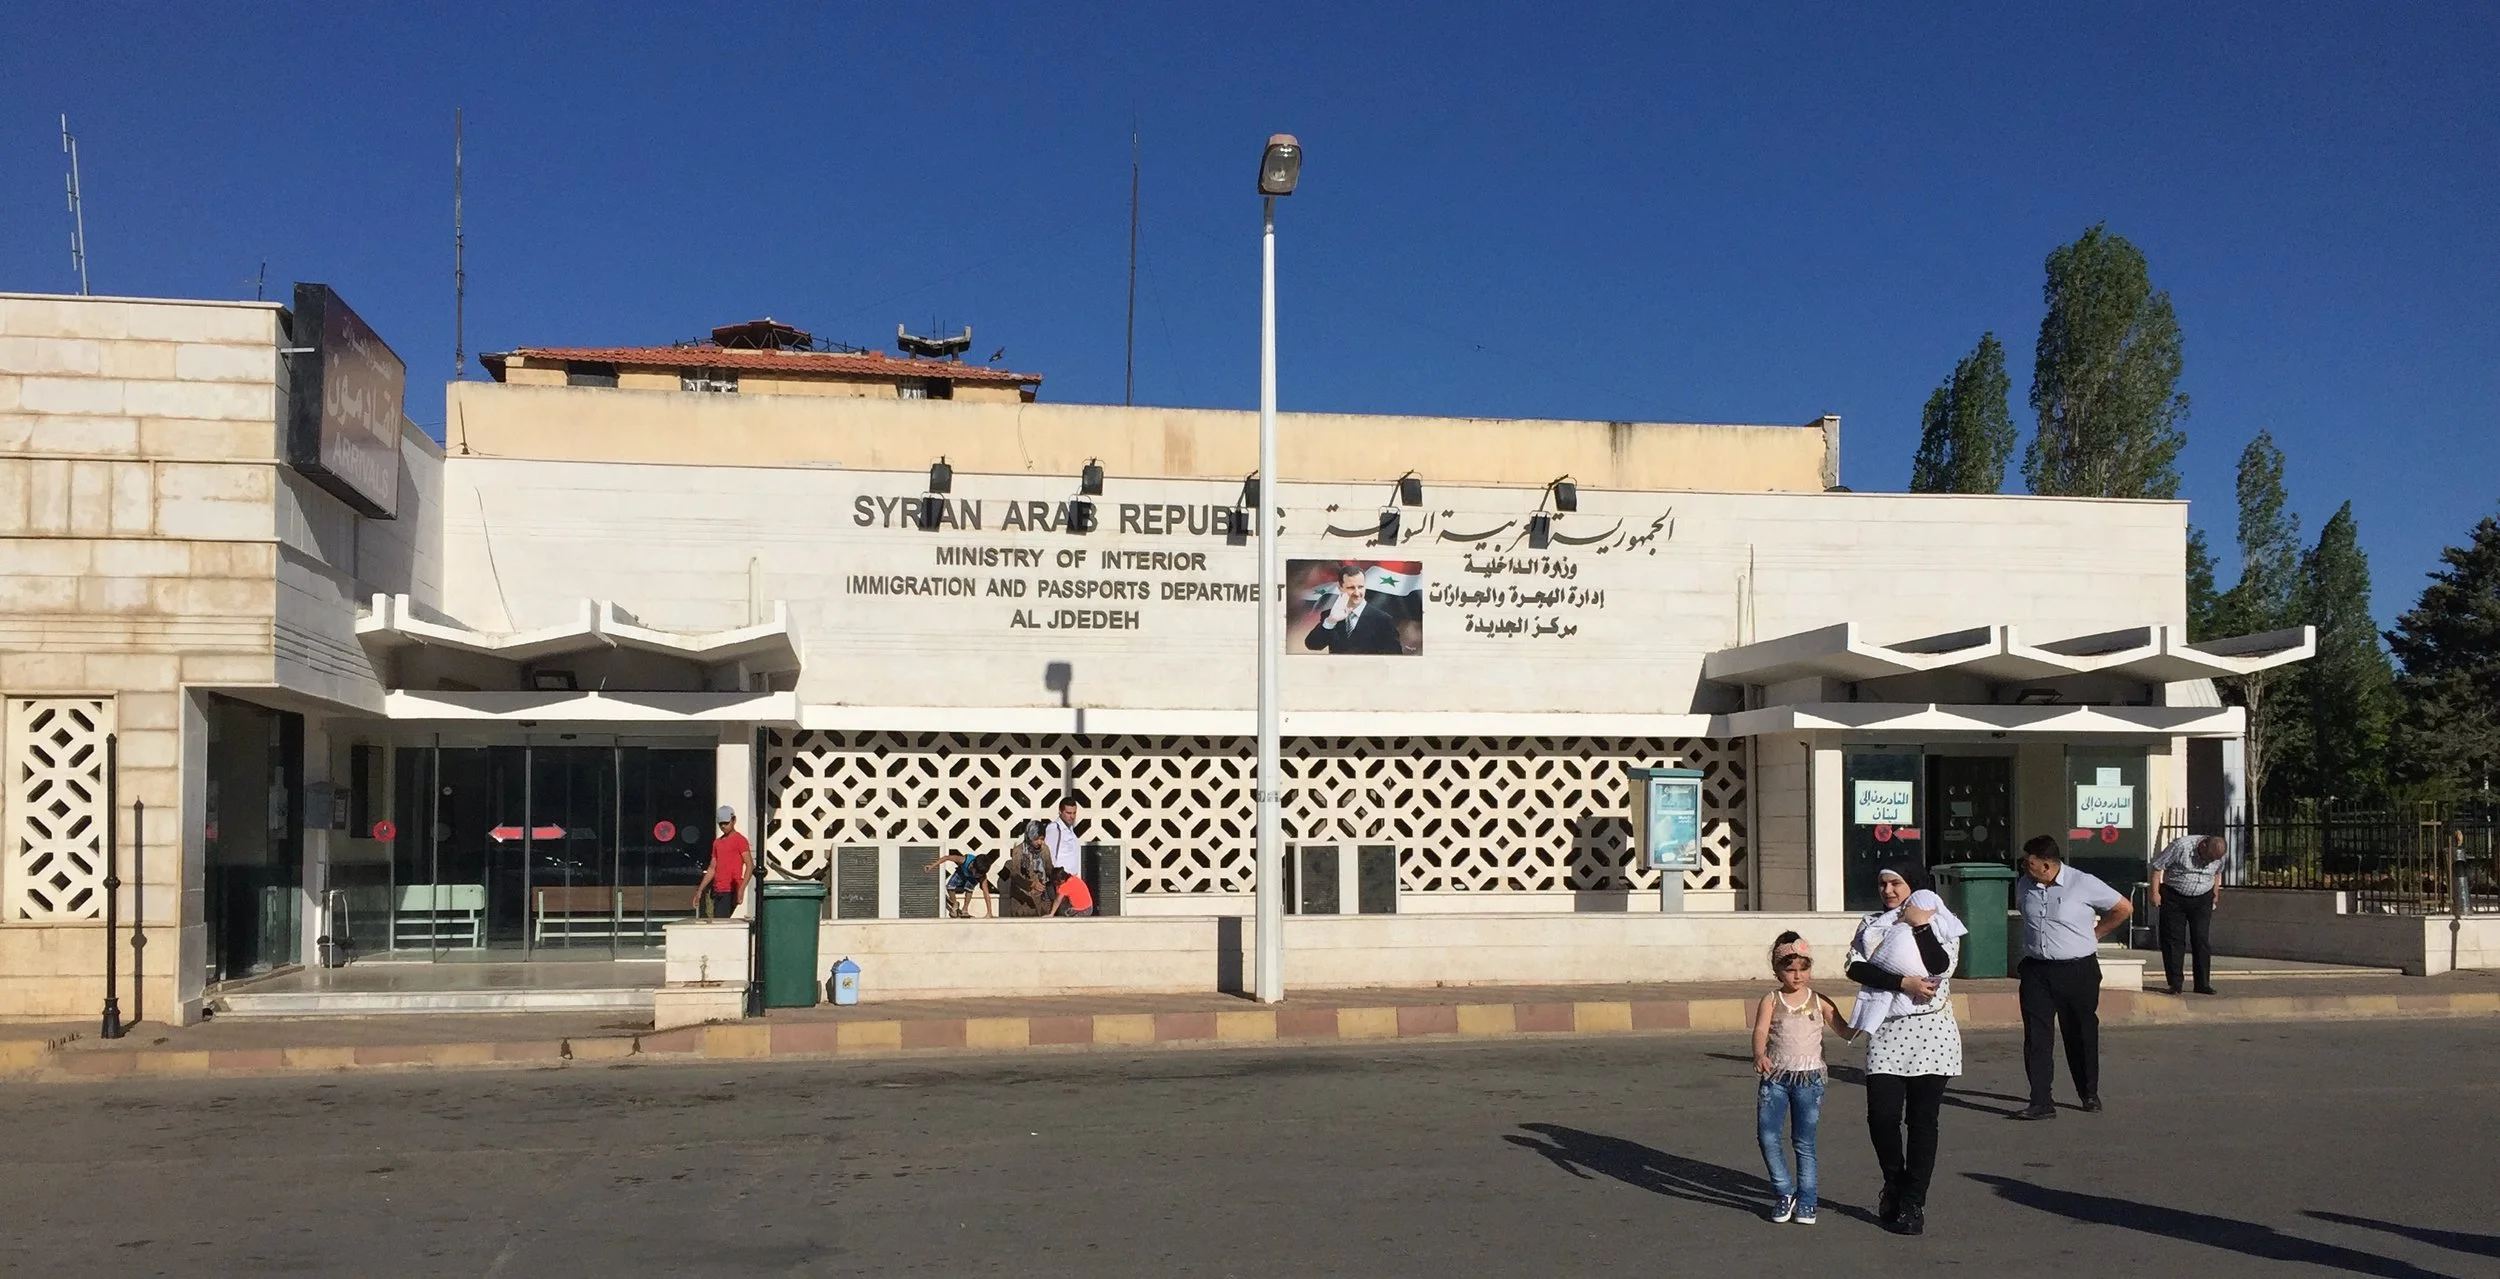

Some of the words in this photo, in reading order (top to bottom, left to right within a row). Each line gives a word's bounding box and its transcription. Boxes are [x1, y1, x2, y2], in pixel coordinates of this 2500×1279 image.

[327, 353, 398, 449] القادمون
[332, 432, 389, 499] ARRIVALS
[853, 495, 982, 531] SYRIAN
[1001, 499, 1099, 532] ARAB
[1321, 503, 1436, 548] السورية
[1436, 510, 1548, 553] العربية
[1546, 506, 1675, 556] الجمهورية
[936, 546, 1045, 568] MINISTRY
[1056, 549, 1087, 569] OF
[1101, 550, 1207, 571] INTERIOR
[1463, 553, 1539, 579] الداخلية
[1540, 555, 1578, 580] وزارة
[846, 575, 976, 597] IMMIGRATION
[986, 578, 1027, 599] AND
[1038, 579, 1151, 600] PASSPORTS
[1160, 582, 1286, 603] DEPARTMET
[1429, 582, 1506, 608] والجوازات
[1508, 585, 1566, 609] الهجرة
[1566, 585, 1605, 609] إدارة
[1010, 609, 1041, 629] AL
[1047, 609, 1140, 630] JDEDEH
[1465, 614, 1529, 639] الجديدة
[1531, 615, 1578, 639] مركز
[1859, 789, 1871, 807] إلى
[1870, 790, 1909, 805] المغادرون
[2080, 795, 2094, 811] إلى
[1872, 807, 1898, 823] لبنان
[2095, 812, 2120, 825] لبنان
